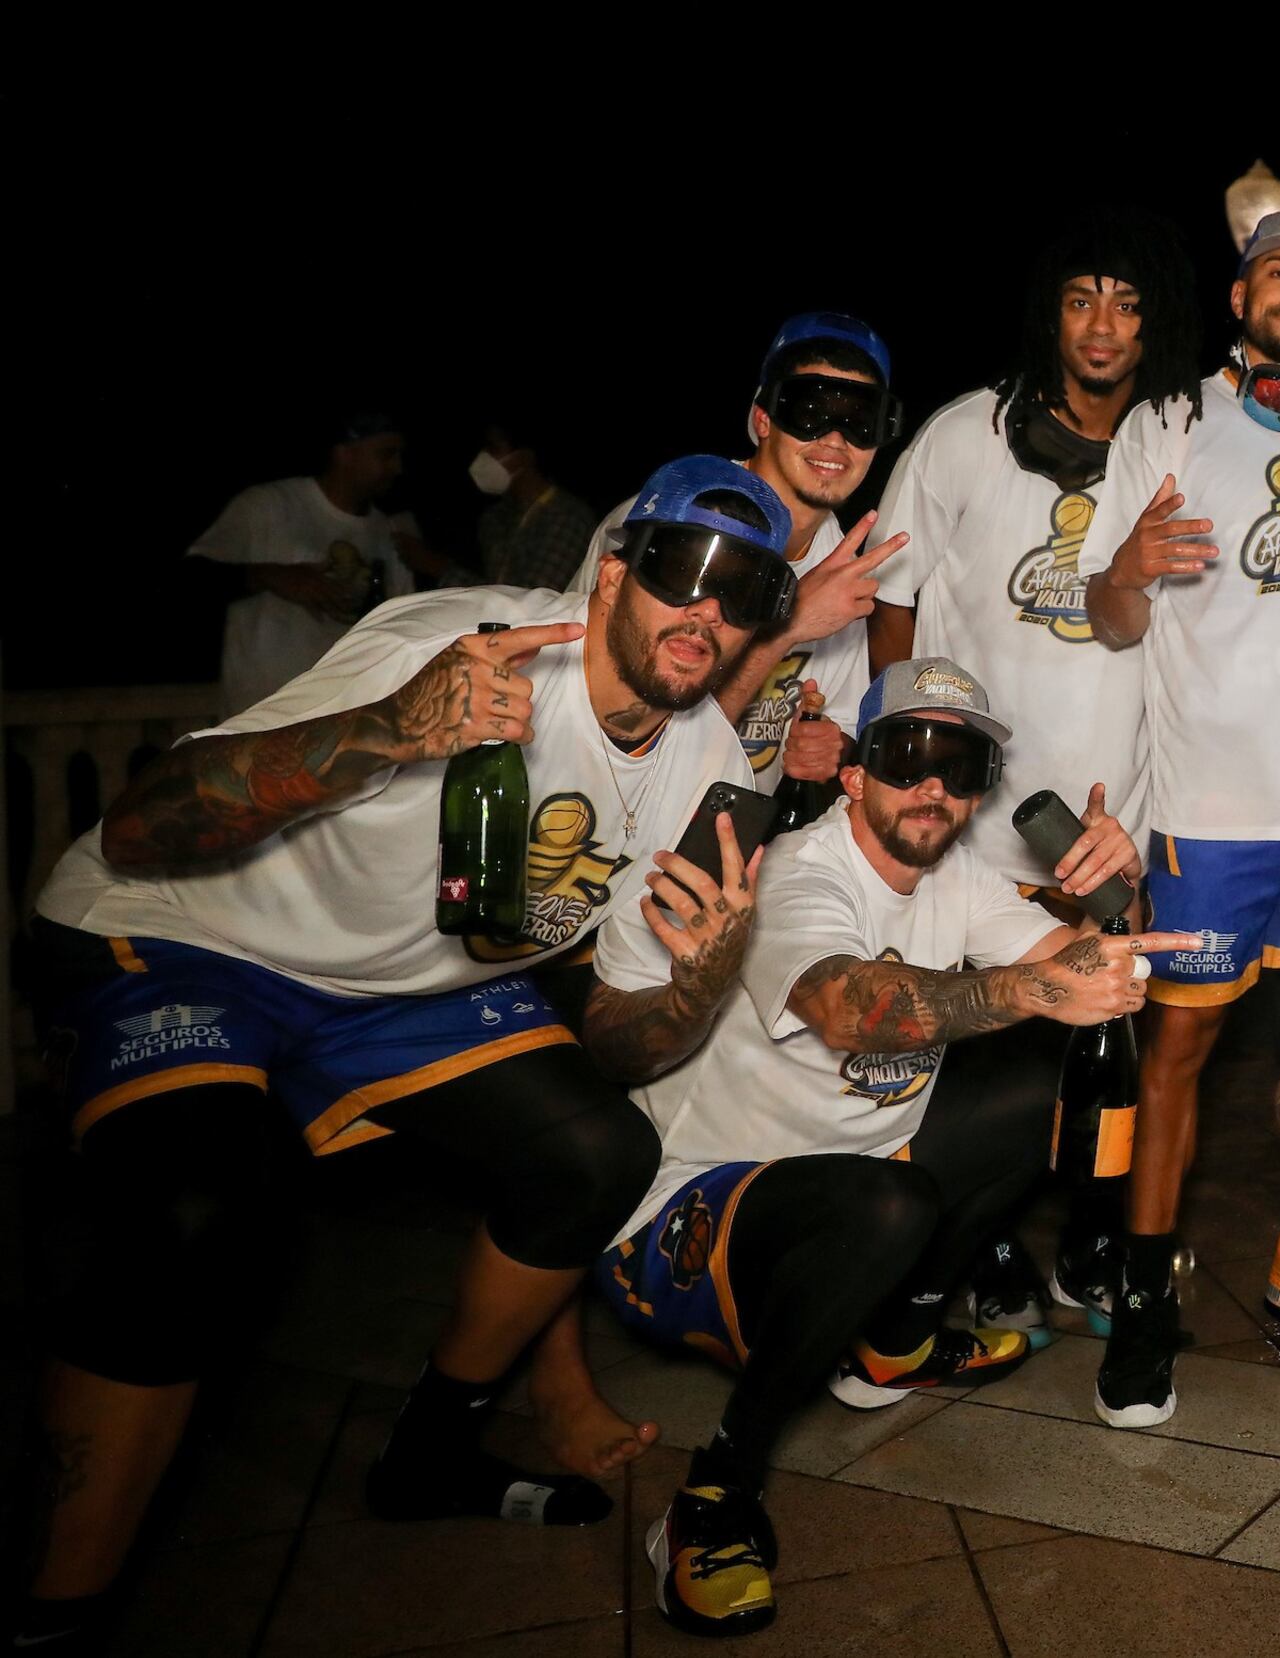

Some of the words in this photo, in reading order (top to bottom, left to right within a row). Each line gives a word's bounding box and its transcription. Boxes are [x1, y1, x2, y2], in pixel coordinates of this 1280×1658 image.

[1018, 614, 1049, 625] 2020
[1175, 952, 1232, 963] SEGUROS
[1169, 961, 1236, 974] MULTIPLES
[119, 1025, 222, 1055] SEGUROS
[110, 1037, 231, 1071] MULTIPLES
